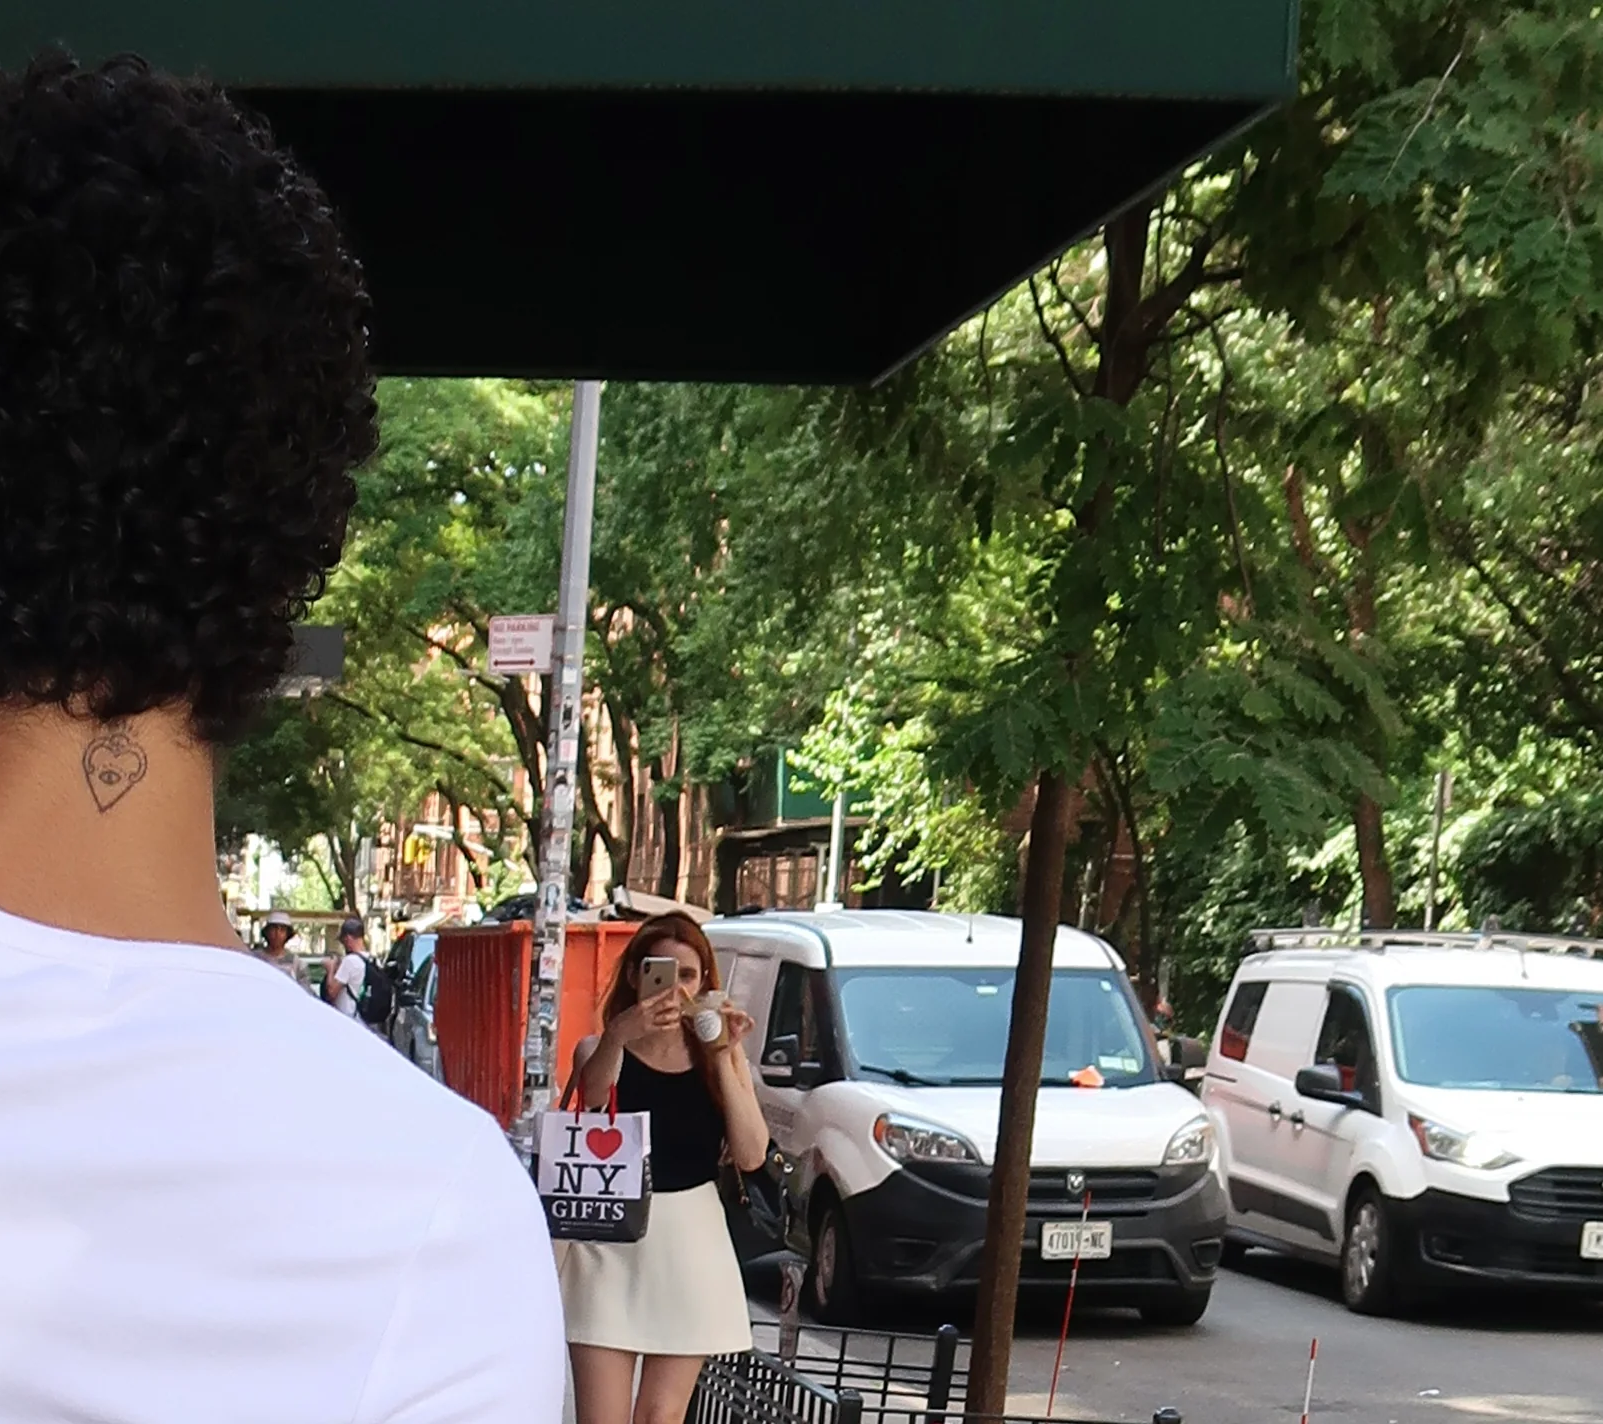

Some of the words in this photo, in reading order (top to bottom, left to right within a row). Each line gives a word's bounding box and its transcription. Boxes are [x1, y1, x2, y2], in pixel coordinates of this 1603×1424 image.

[563, 1126, 582, 1158] I
[552, 1162, 627, 1195] NY
[551, 1200, 625, 1221] GIFTS
